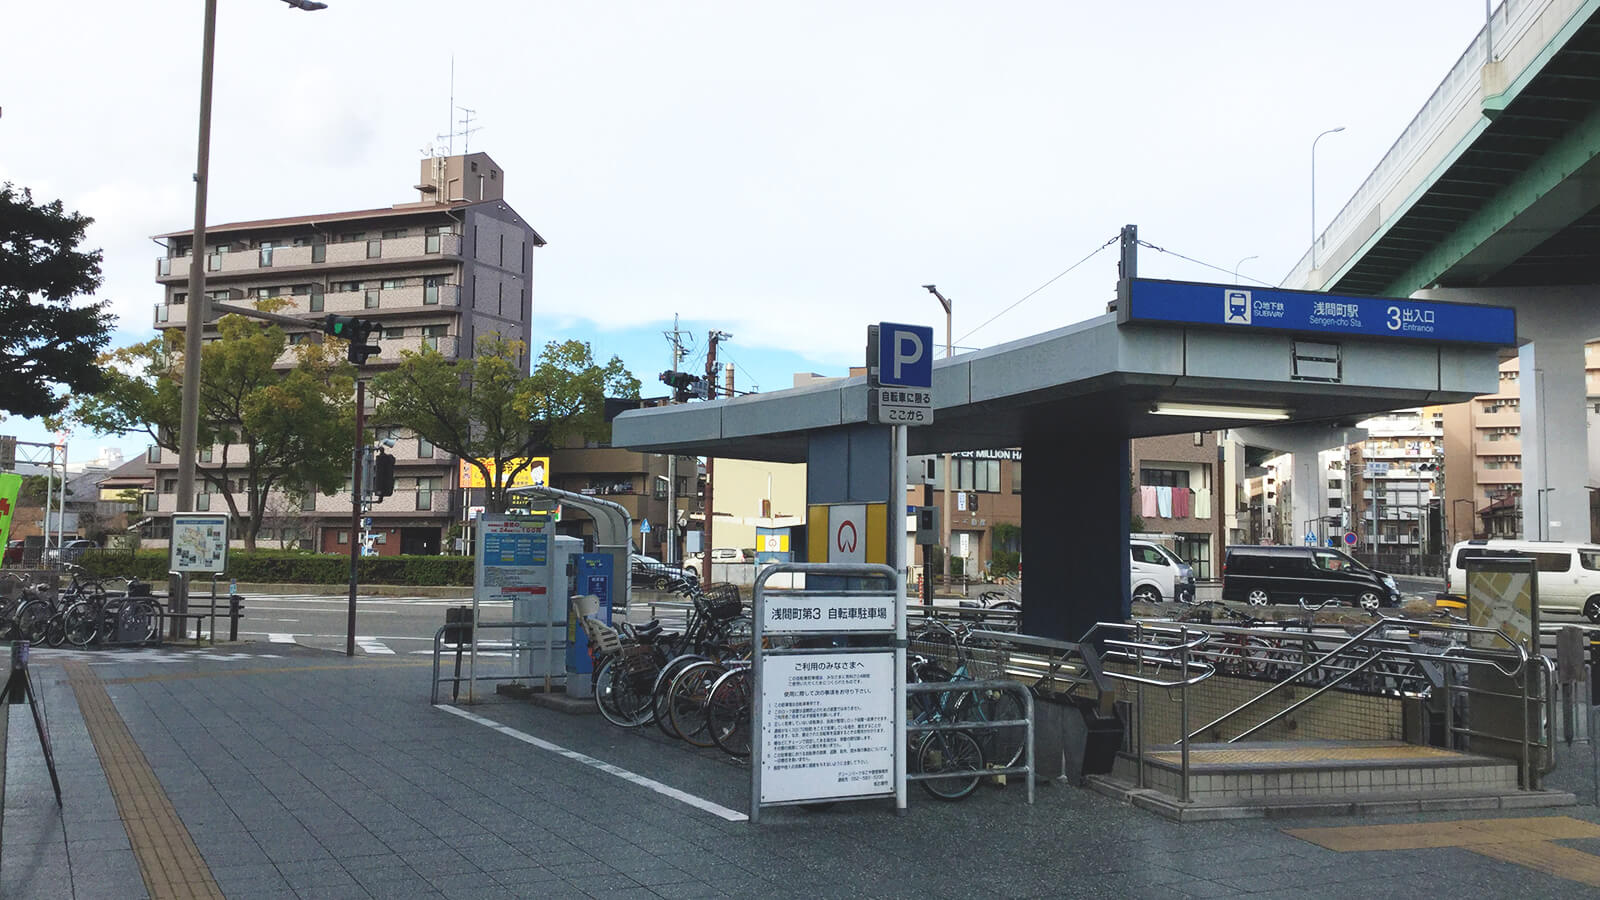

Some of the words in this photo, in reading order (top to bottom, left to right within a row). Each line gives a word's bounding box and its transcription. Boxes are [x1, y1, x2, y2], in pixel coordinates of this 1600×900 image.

[1262, 301, 1285, 311] 地下鉄
[1313, 301, 1359, 318] 浅間町駅
[1254, 310, 1285, 318] SUBWAY
[1386, 306, 1402, 331] 3
[1402, 308, 1435, 324] 出入口
[1309, 315, 1350, 327] Sengen-cho
[1402, 322, 1435, 333] Entrance
[893, 330, 924, 379] P
[881, 391, 931, 404] 自転車に限る
[888, 409, 924, 421] ここから
[975, 449, 1011, 460] MILLION
[771, 607, 821, 621] 浅間町第3
[828, 607, 887, 620] 自転車駐車場
[794, 661, 865, 671] ご利用のみなさまへ
